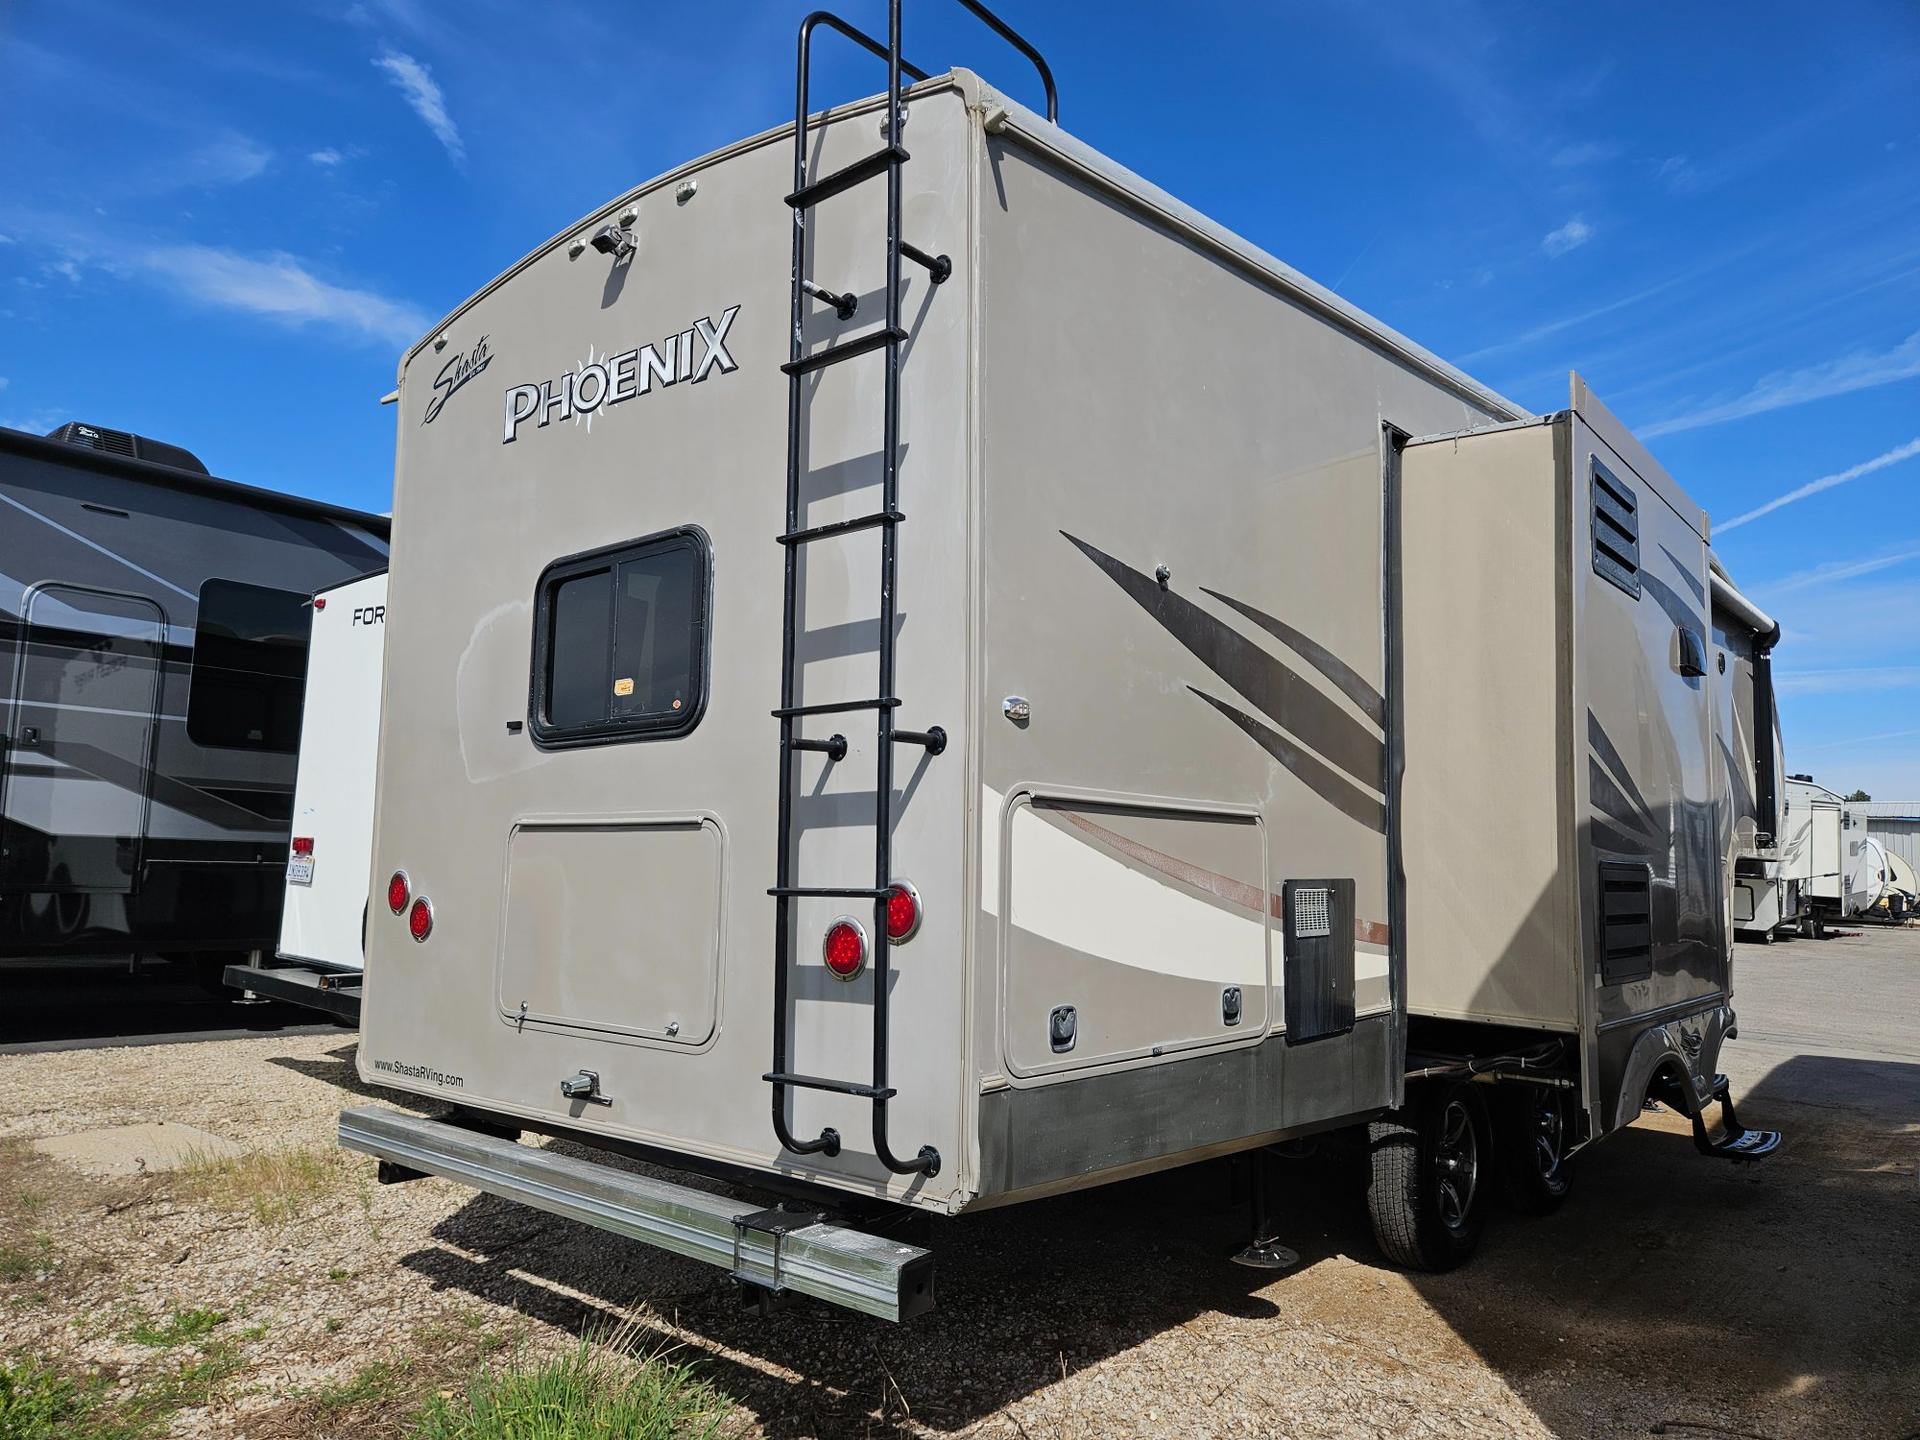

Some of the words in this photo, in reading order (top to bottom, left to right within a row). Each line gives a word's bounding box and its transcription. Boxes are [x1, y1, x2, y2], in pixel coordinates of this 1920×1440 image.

[421, 334, 492, 427] Shasta
[503, 304, 741, 444] PHOENIX
[374, 1059, 464, 1088] www.ShastaRVing.com
